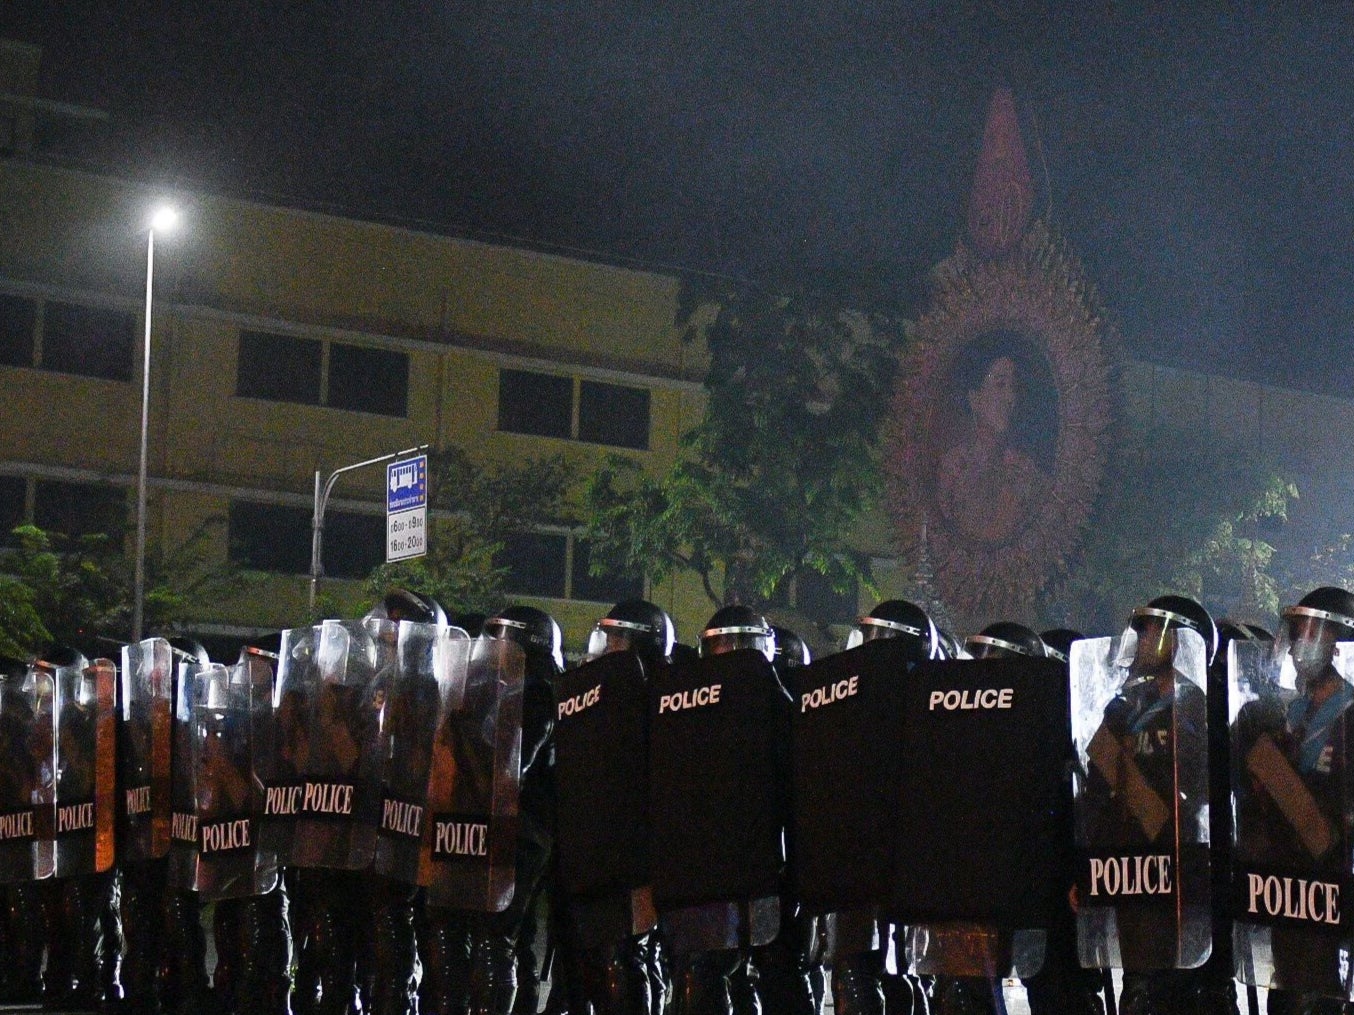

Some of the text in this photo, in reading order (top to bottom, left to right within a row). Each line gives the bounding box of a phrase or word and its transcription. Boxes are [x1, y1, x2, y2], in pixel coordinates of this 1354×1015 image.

[558, 685, 600, 720] POLICE
[659, 685, 721, 713] POLICE
[802, 676, 858, 712] POLICE
[930, 689, 1013, 710] POLICE
[265, 787, 302, 814] POLIC
[303, 783, 353, 814] POLICE
[0, 812, 33, 839] POLICE
[59, 803, 93, 832] POLICE
[172, 813, 198, 842] POLICE
[382, 799, 423, 836] POLICE
[203, 820, 250, 852] POLICE
[435, 822, 487, 855] POLICE
[1090, 856, 1171, 895] POLICE
[1248, 874, 1340, 924] POLICE
